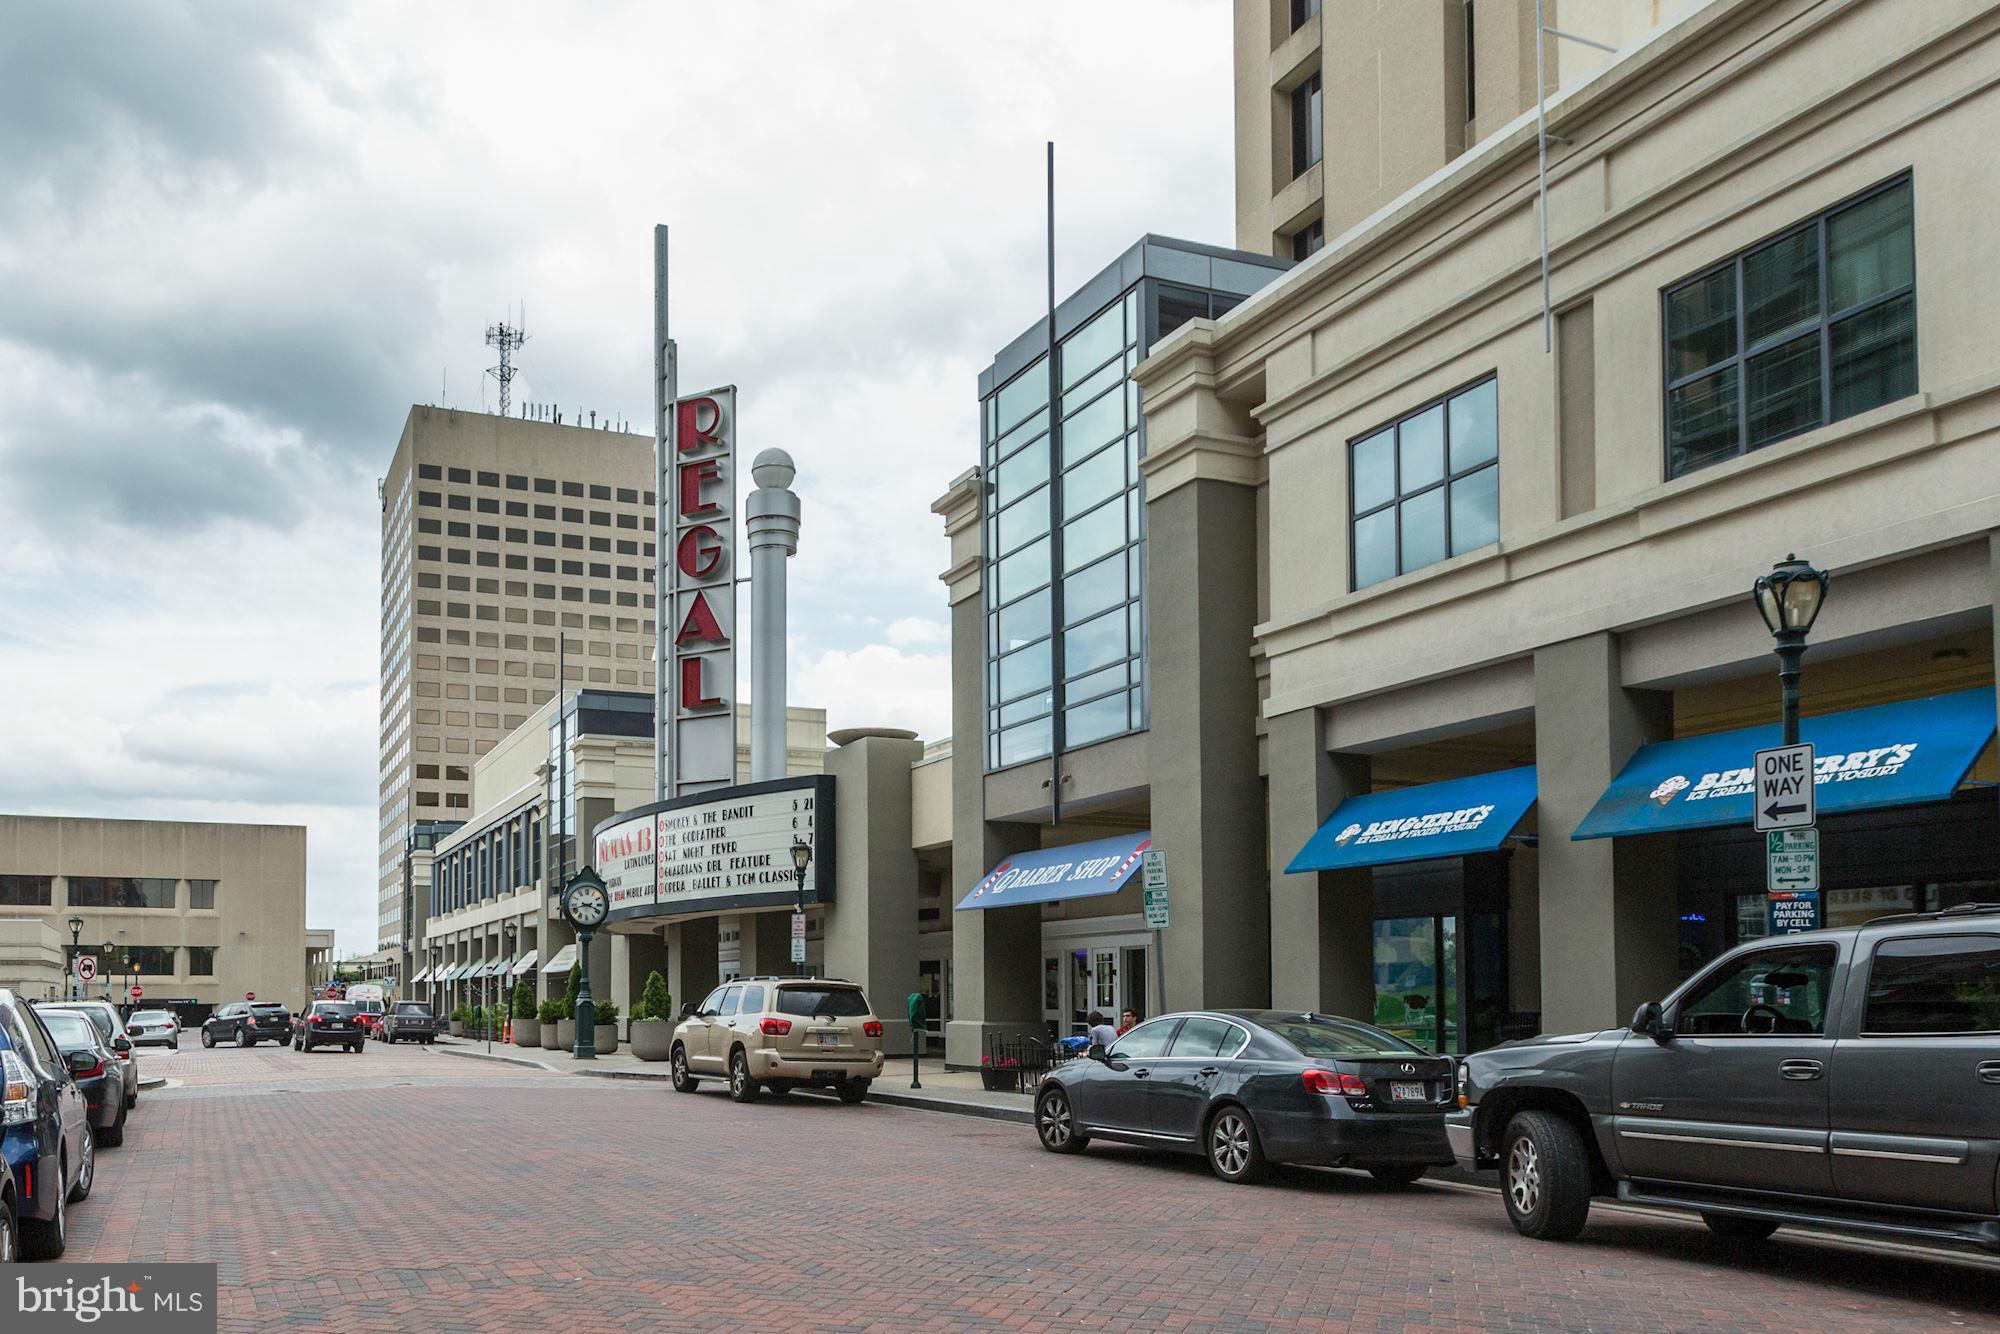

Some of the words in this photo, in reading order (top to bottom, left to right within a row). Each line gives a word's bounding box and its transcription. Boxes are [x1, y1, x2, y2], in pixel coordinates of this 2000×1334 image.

[675, 398, 728, 710] REGAL
[1764, 753, 1804, 775] ONE
[1685, 789, 1710, 802] ICE
[1835, 764, 1904, 782] YOGURT
[1764, 775, 1805, 798] WAY
[703, 811, 717, 824] THE
[722, 805, 754, 821] BANDIT
[804, 797, 814, 810] 21
[665, 834, 677, 846] THE
[683, 826, 726, 843] GODFATHER
[792, 817, 798, 829] 6
[1442, 820, 1483, 834] YOGURT
[637, 827, 651, 852] 13
[1784, 841, 1815, 850] PARKING
[665, 849, 677, 862] SAT
[683, 846, 704, 859] NIGHT
[712, 841, 738, 855] FEVER
[665, 862, 703, 877] GUARDIANS
[707, 860, 722, 872] DBL
[730, 855, 771, 870] FEATURE
[1007, 863, 1073, 889] BARBER
[1067, 856, 1121, 881] SHOP
[665, 881, 685, 893] OPERA
[692, 876, 721, 889] BALLET
[726, 875, 732, 887] &
[736, 873, 755, 885] TCM
[1773, 910, 1815, 919] PARKING
[1776, 902, 1793, 910] PAY
[1793, 901, 1812, 910] FOR
[1776, 919, 1790, 927] BY
[1790, 918, 1812, 927] CELL
[1632, 1102, 1664, 1111] TAHOE
